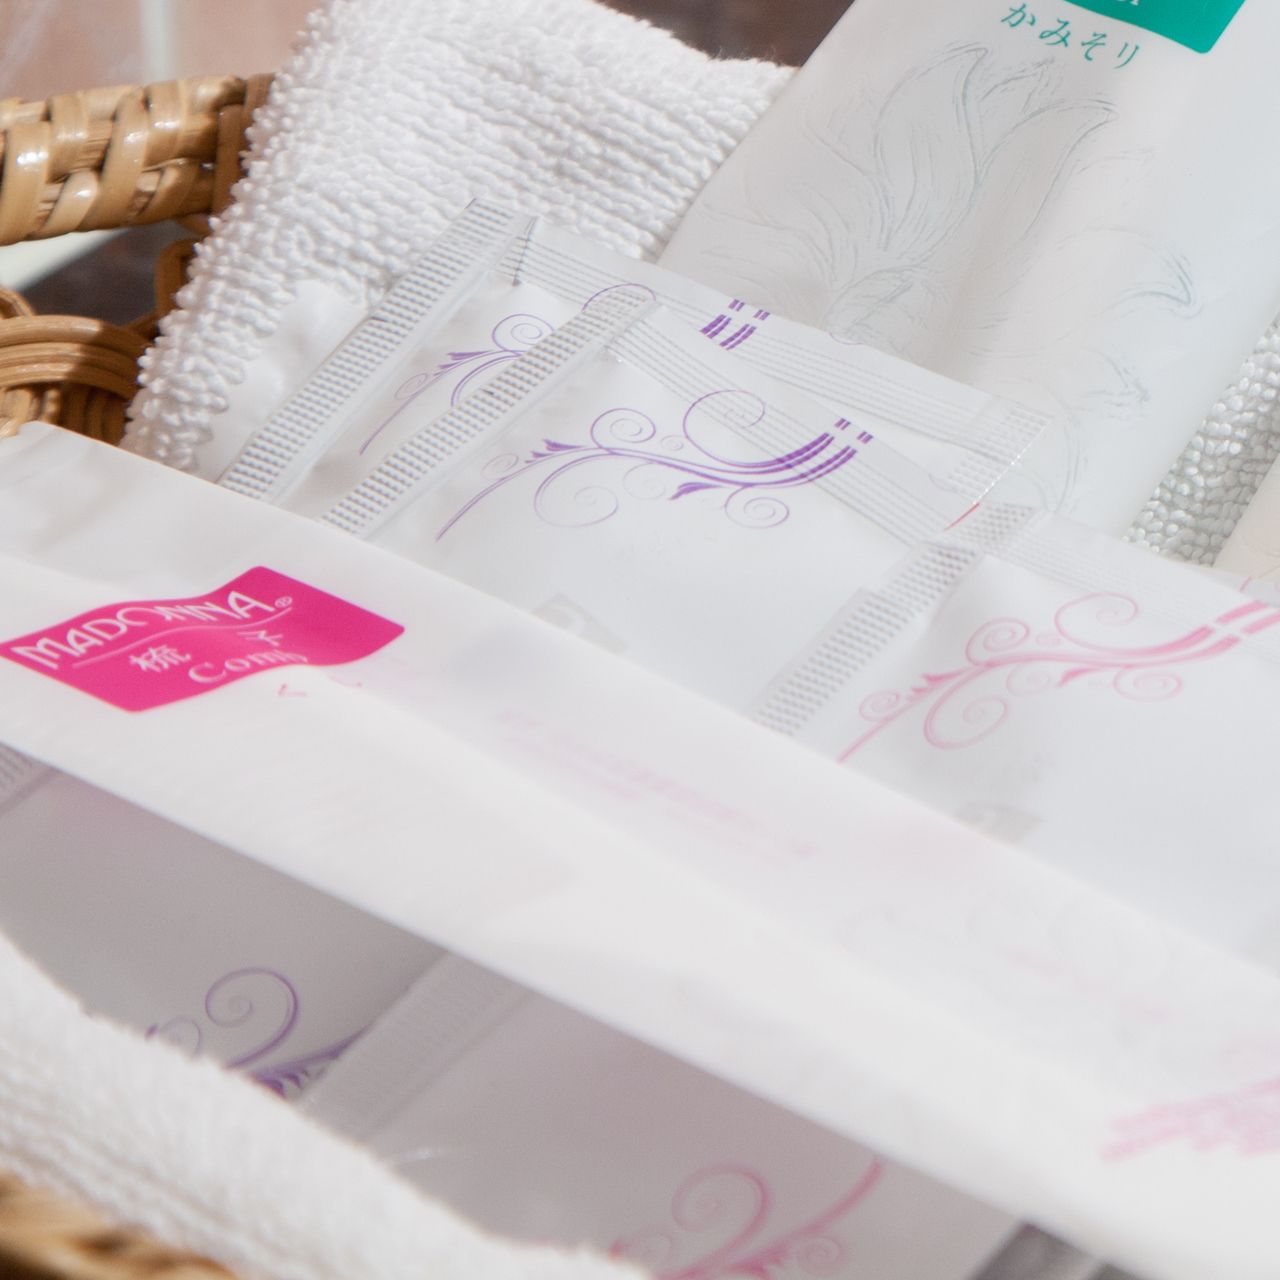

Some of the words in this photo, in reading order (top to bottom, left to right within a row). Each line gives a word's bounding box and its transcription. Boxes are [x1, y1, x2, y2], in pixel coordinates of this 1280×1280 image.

[1000, 1, 1141, 70] かみそり
[9, 590, 277, 671] MADONNA
